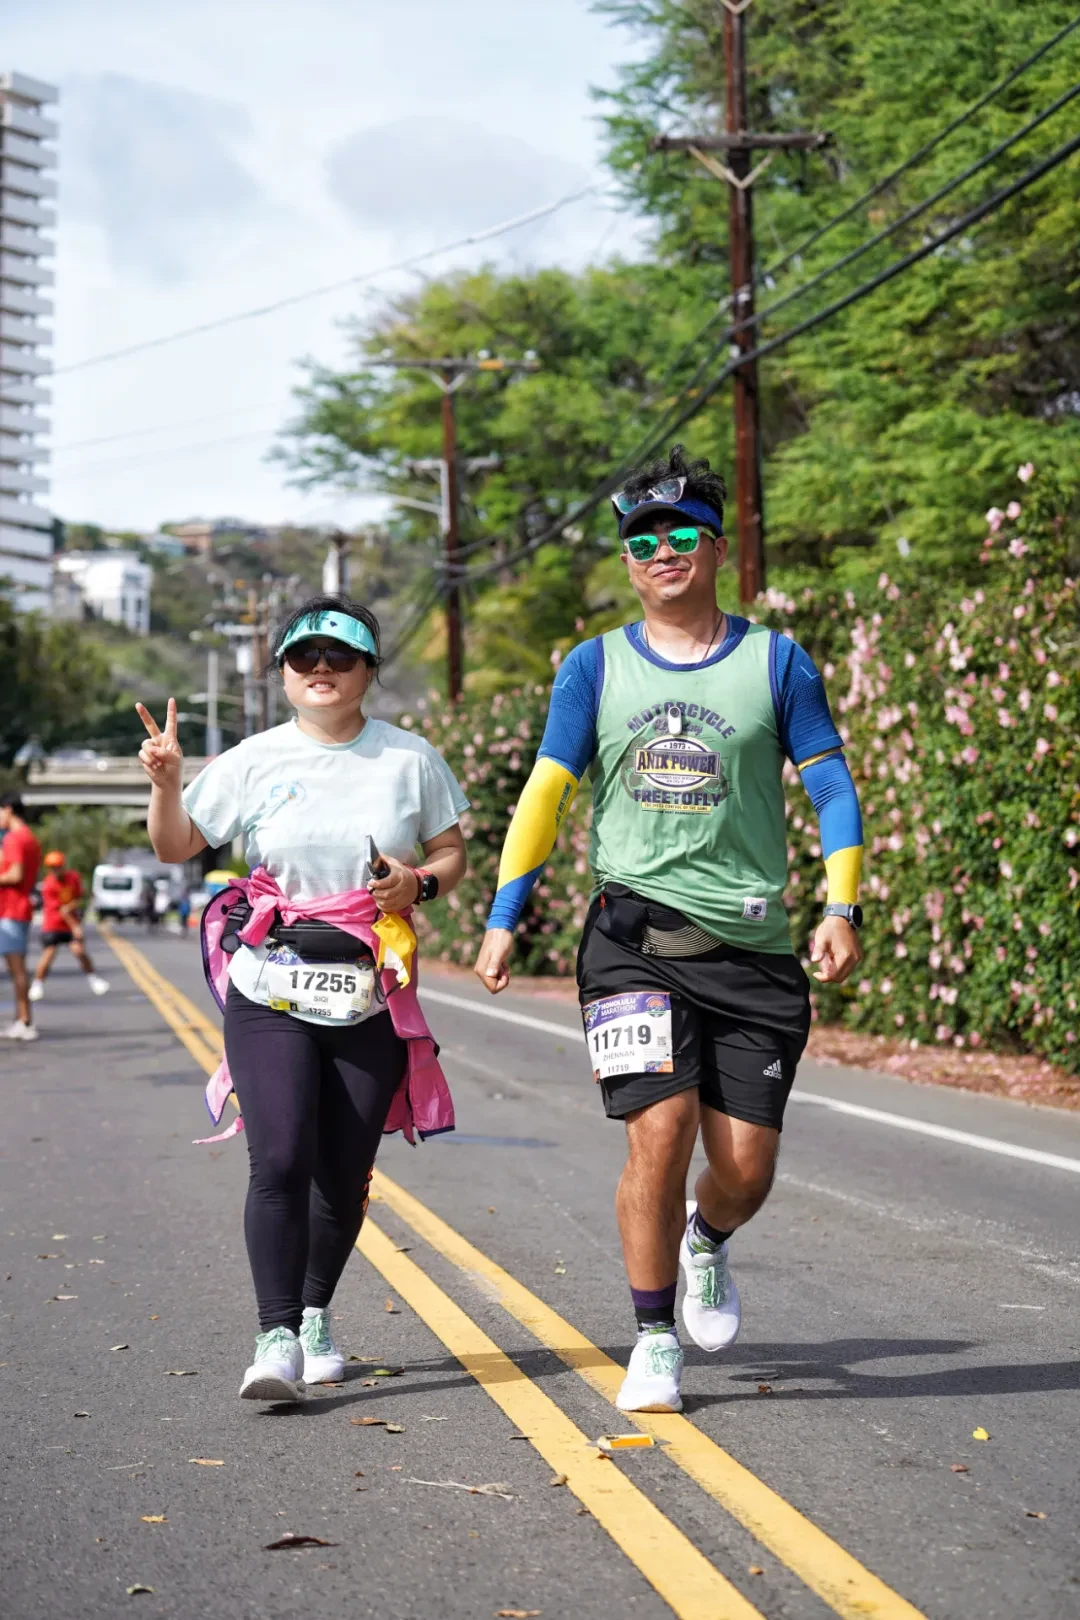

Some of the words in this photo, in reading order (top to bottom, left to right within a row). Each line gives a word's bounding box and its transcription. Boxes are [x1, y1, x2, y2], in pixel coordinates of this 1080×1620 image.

[669, 742, 686, 750] 1973
[671, 754, 717, 775] POWER
[289, 970, 357, 993] 17255
[601, 998, 636, 1010] HONOLULU
[308, 1007, 332, 1017] 17255
[601, 1005, 637, 1016] MARATHON
[593, 1024, 652, 1053] 11719
[607, 1064, 630, 1074] 11719
[763, 1069, 782, 1080] adida
